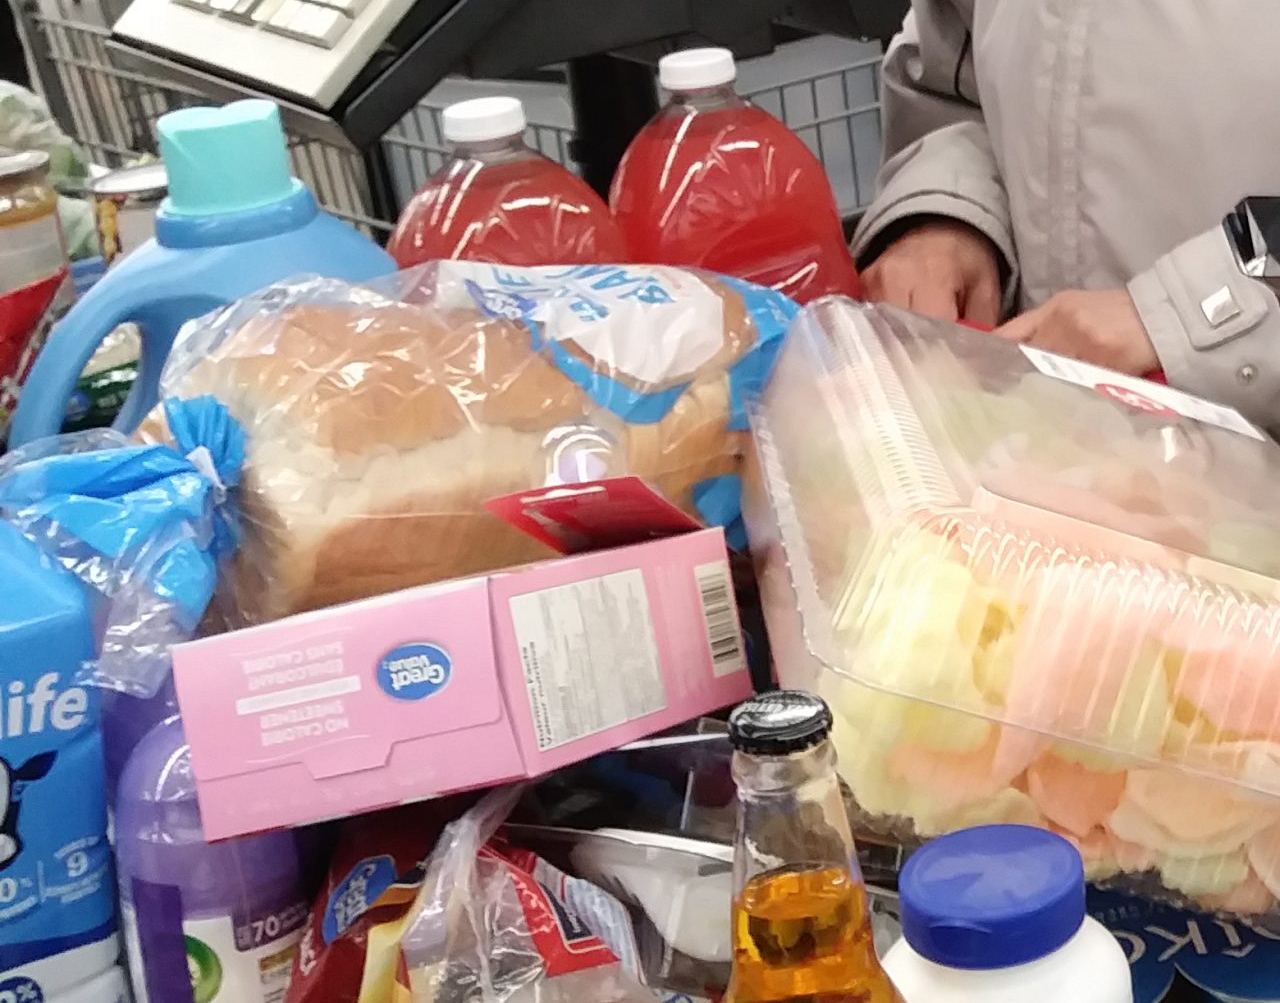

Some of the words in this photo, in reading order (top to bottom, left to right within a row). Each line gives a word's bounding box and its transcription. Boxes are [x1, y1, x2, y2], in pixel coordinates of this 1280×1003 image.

[386, 653, 432, 673] Value
[390, 662, 446, 691] Great
[259, 700, 345, 730] SWEETENER
[325, 717, 349, 733] NO
[531, 686, 545, 749] Nutrition
[261, 724, 322, 747] CALORIE
[251, 915, 281, 942] 70
